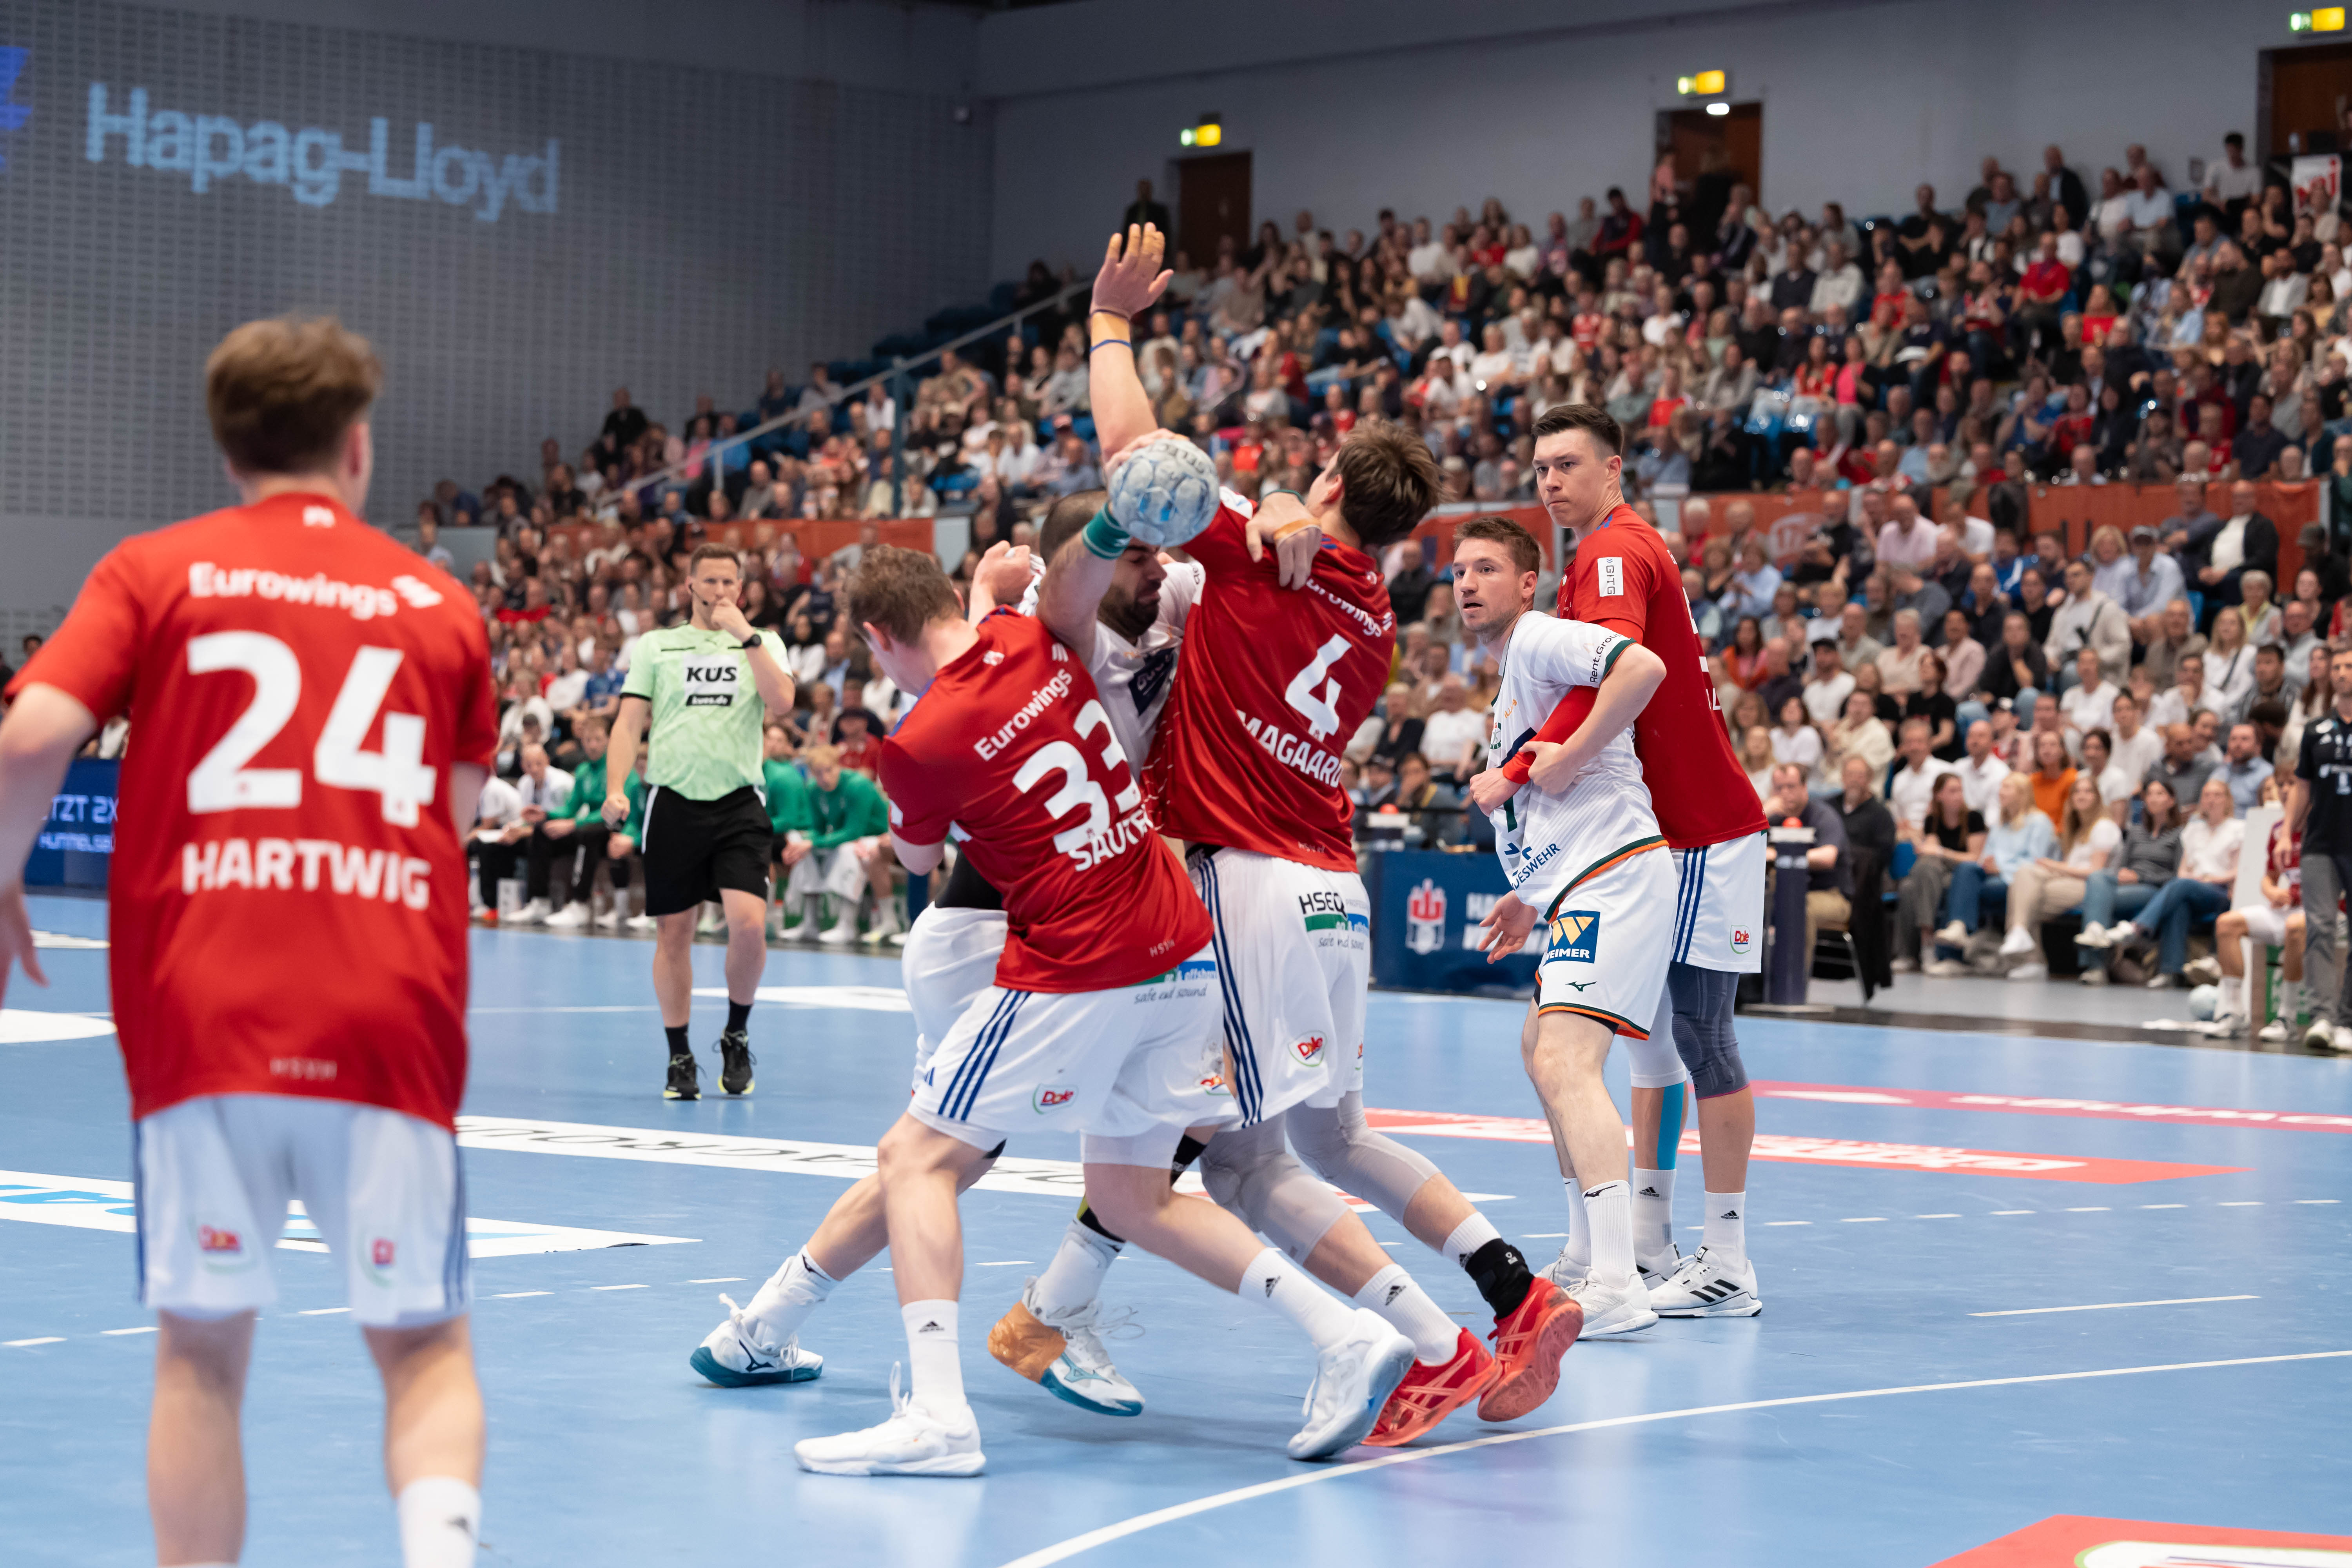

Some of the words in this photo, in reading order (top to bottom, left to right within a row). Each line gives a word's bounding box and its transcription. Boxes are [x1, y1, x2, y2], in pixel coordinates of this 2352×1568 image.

[85, 81, 561, 222] Hapag-Lloyd
[188, 561, 397, 620] Eurowings
[1306, 579, 1382, 637] uowings
[1606, 565, 1615, 595] GITG
[974, 668, 1073, 762] Eurowings
[1285, 633, 1352, 743] 4
[186, 630, 438, 828] 24
[1012, 699, 1142, 854] 33
[182, 837, 432, 910] HARTWIG
[1298, 891, 1348, 919] HSEQ
[1734, 930, 1749, 944] Dole
[1041, 1090, 1074, 1105] Dole
